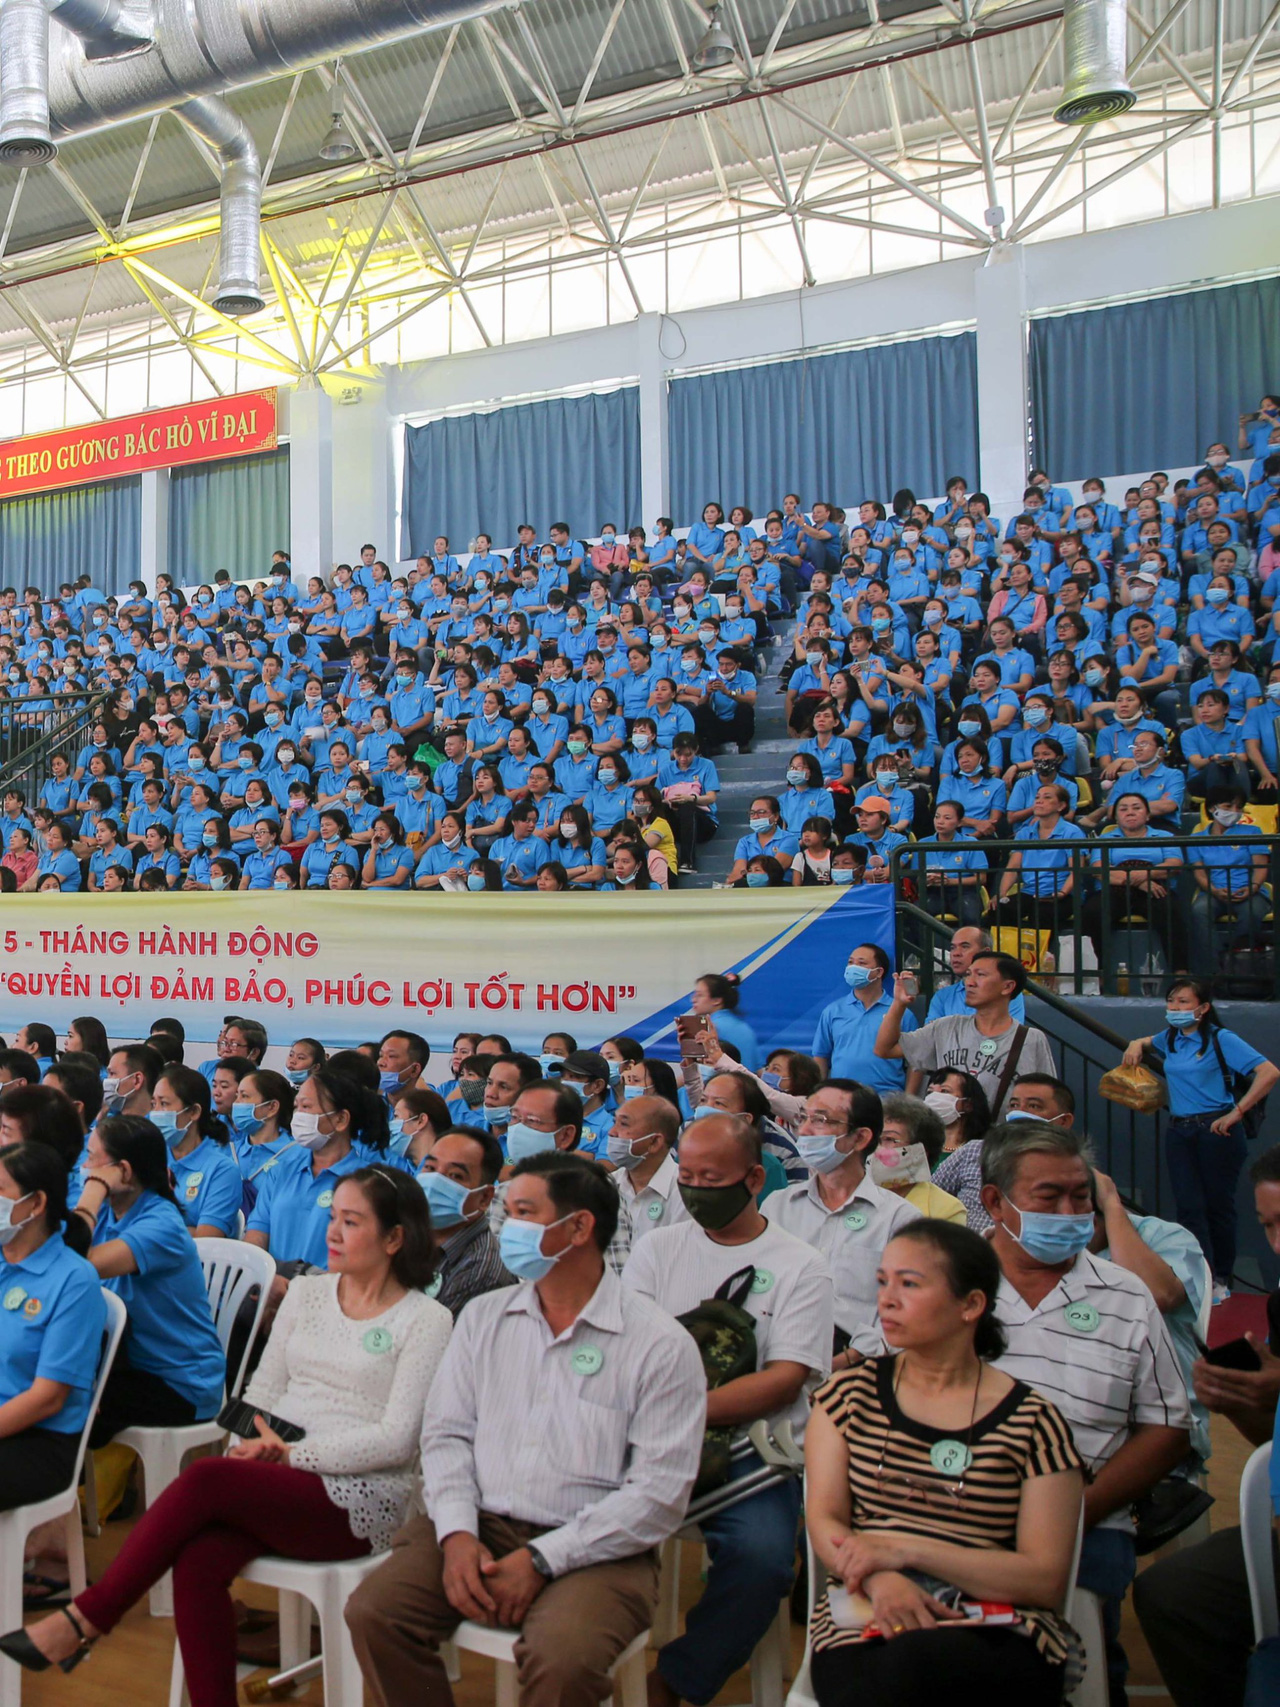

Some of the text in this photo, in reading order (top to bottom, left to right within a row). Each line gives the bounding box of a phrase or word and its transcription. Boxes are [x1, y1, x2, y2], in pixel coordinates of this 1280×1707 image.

[6, 451, 52, 480] THEO
[56, 436, 119, 470] GƯƠNG
[124, 423, 161, 457] BÁC
[166, 415, 193, 450] HỒ
[197, 410, 218, 443] VĨ
[222, 409, 257, 442] ĐẠI
[4, 931, 18, 953] 5
[39, 924, 129, 955] THÁNG
[138, 924, 217, 956] HÀNH
[227, 924, 319, 963] ĐỘNG
[100, 971, 141, 1006] LỢI
[150, 968, 214, 1001] ĐẢM
[224, 968, 295, 1009] BẢO,
[305, 972, 391, 1007] PHÚC
[403, 978, 453, 1016] LỢI
[463, 971, 525, 1010] TỐT
